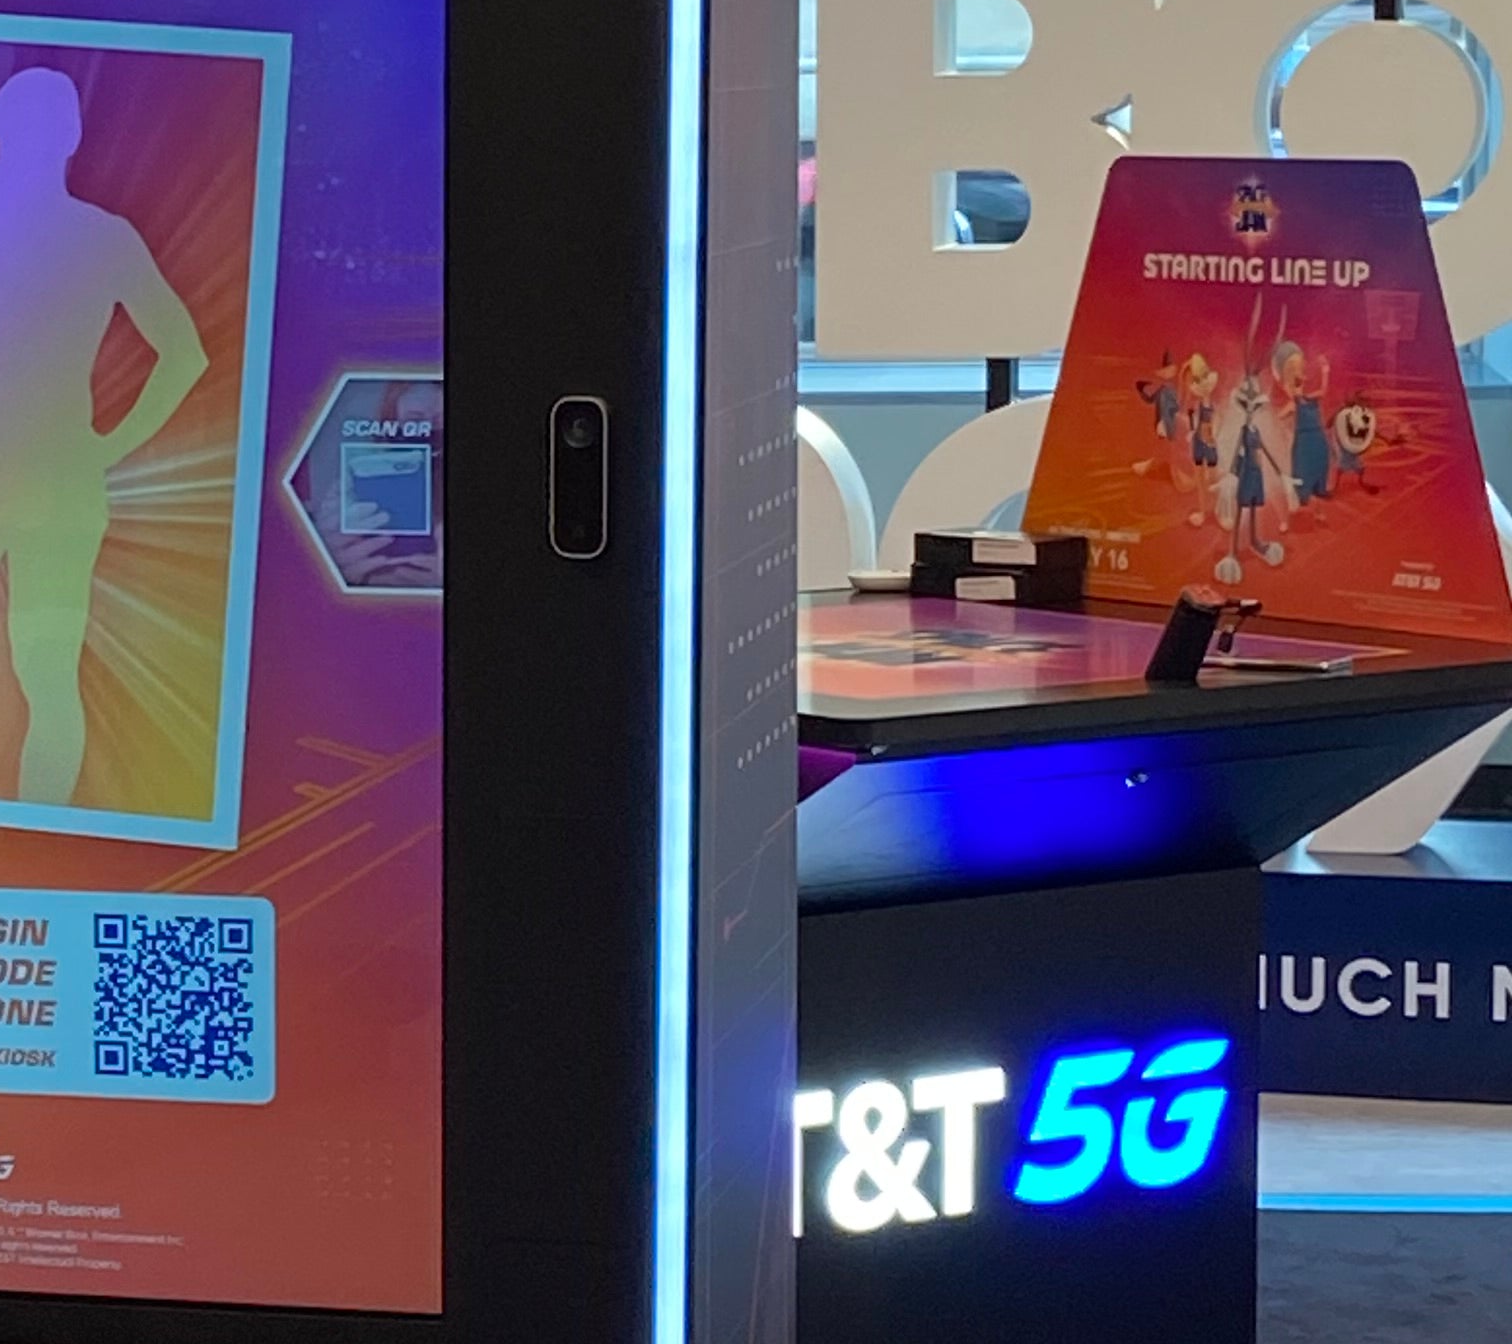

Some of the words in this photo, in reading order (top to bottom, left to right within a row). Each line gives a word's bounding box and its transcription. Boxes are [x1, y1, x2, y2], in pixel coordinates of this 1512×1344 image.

[1143, 252, 1265, 285] STARTING
[1270, 257, 1327, 286] LINE
[1333, 259, 1372, 288] UP
[341, 419, 399, 438] SCAN
[401, 420, 433, 438] QR
[1107, 548, 1130, 571] 16
[1259, 953, 1451, 1020] UCH
[1014, 1036, 1231, 1206] 5G
